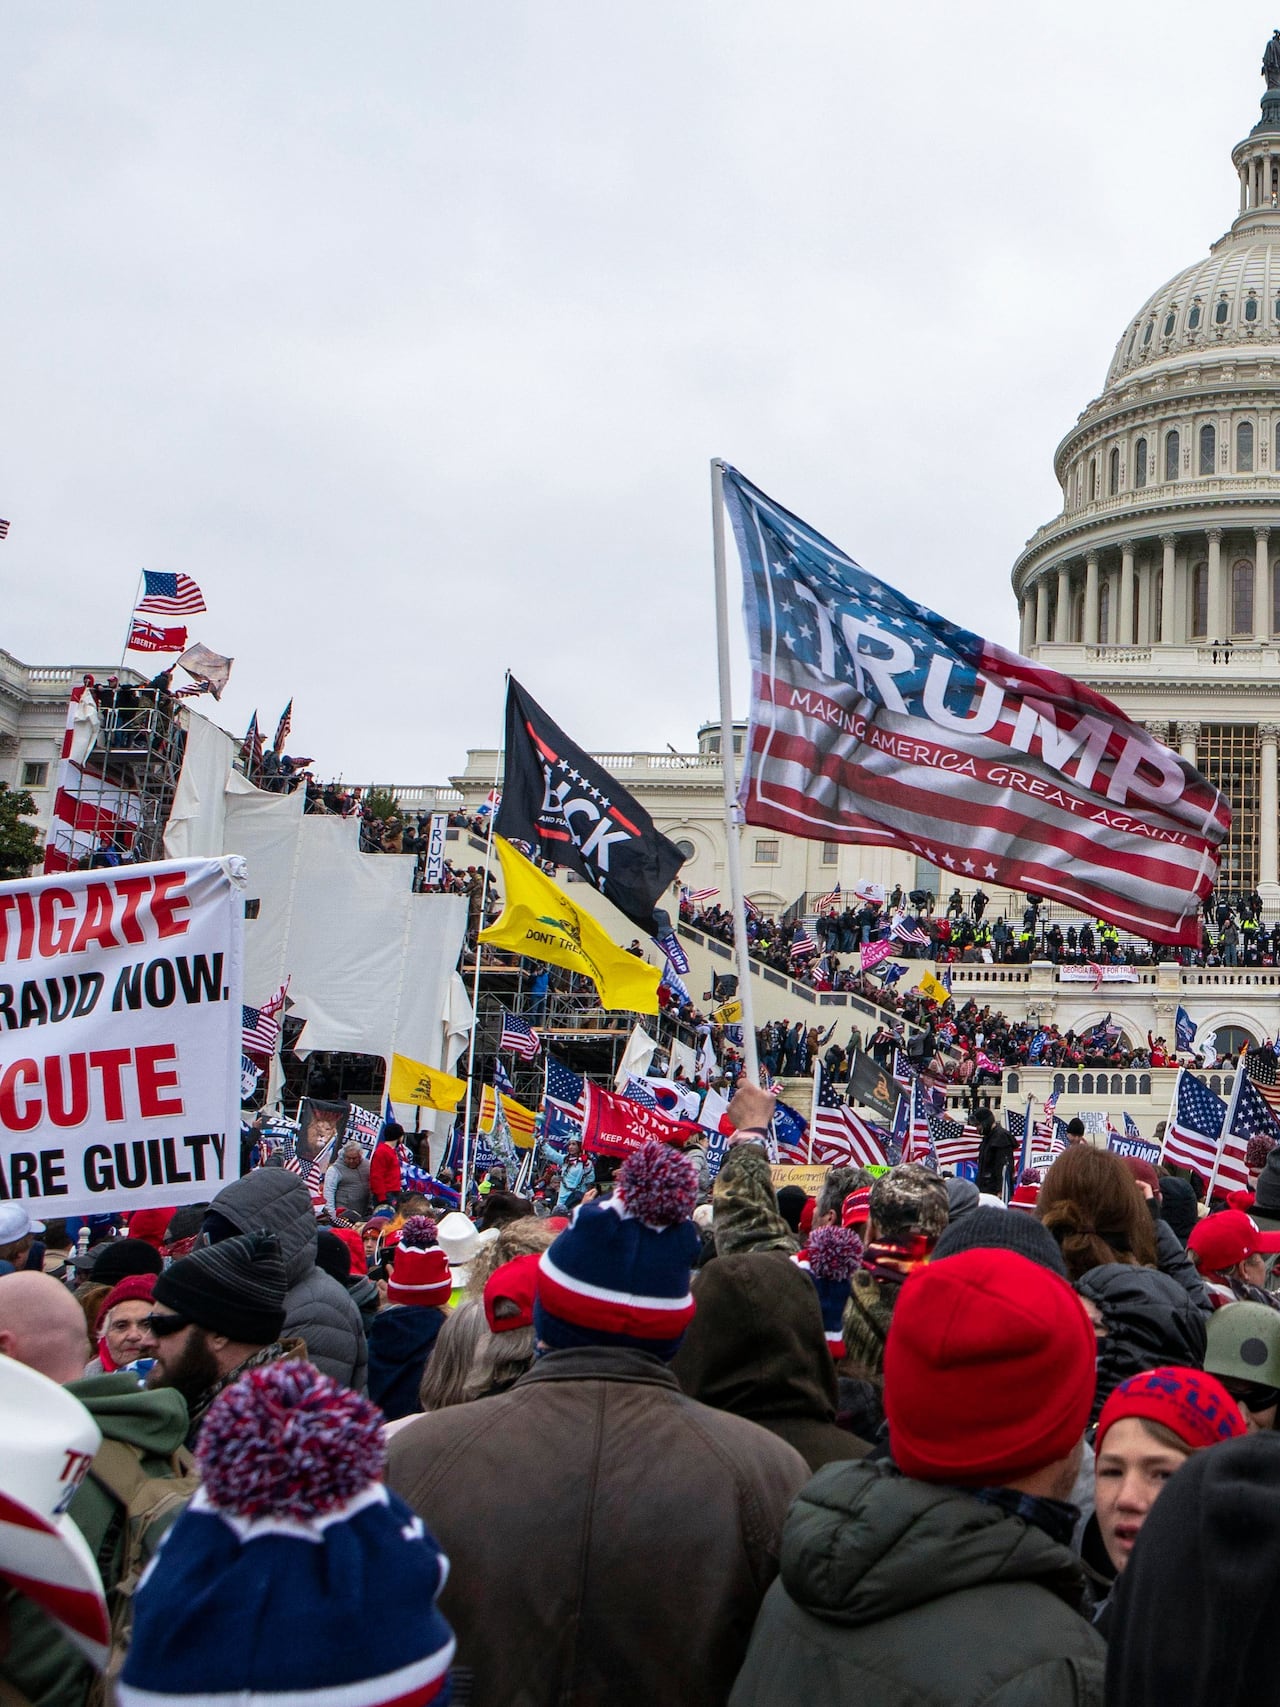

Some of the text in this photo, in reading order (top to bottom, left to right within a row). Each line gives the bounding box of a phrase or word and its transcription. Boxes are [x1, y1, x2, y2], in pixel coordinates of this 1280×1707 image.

[131, 636, 157, 650] LIBERTY
[793, 581, 1187, 806] TRUMP
[789, 688, 1188, 846] MAKING AMERICA GREAT AGAIN!
[538, 814, 555, 824] AND
[428, 817, 444, 882] TRUMP
[665, 933, 687, 973] TRUMP
[1063, 966, 1088, 974] GEORGIA
[0, 951, 229, 1030] RAUD NOW.
[0, 1043, 183, 1133] CUTE
[1080, 1112, 1103, 1120] SEND
[600, 1132, 622, 1142] KEEP
[1112, 1140, 1160, 1162] TRUMP
[83, 1133, 226, 1193] GUILTY
[476, 1153, 497, 1161] 2020
